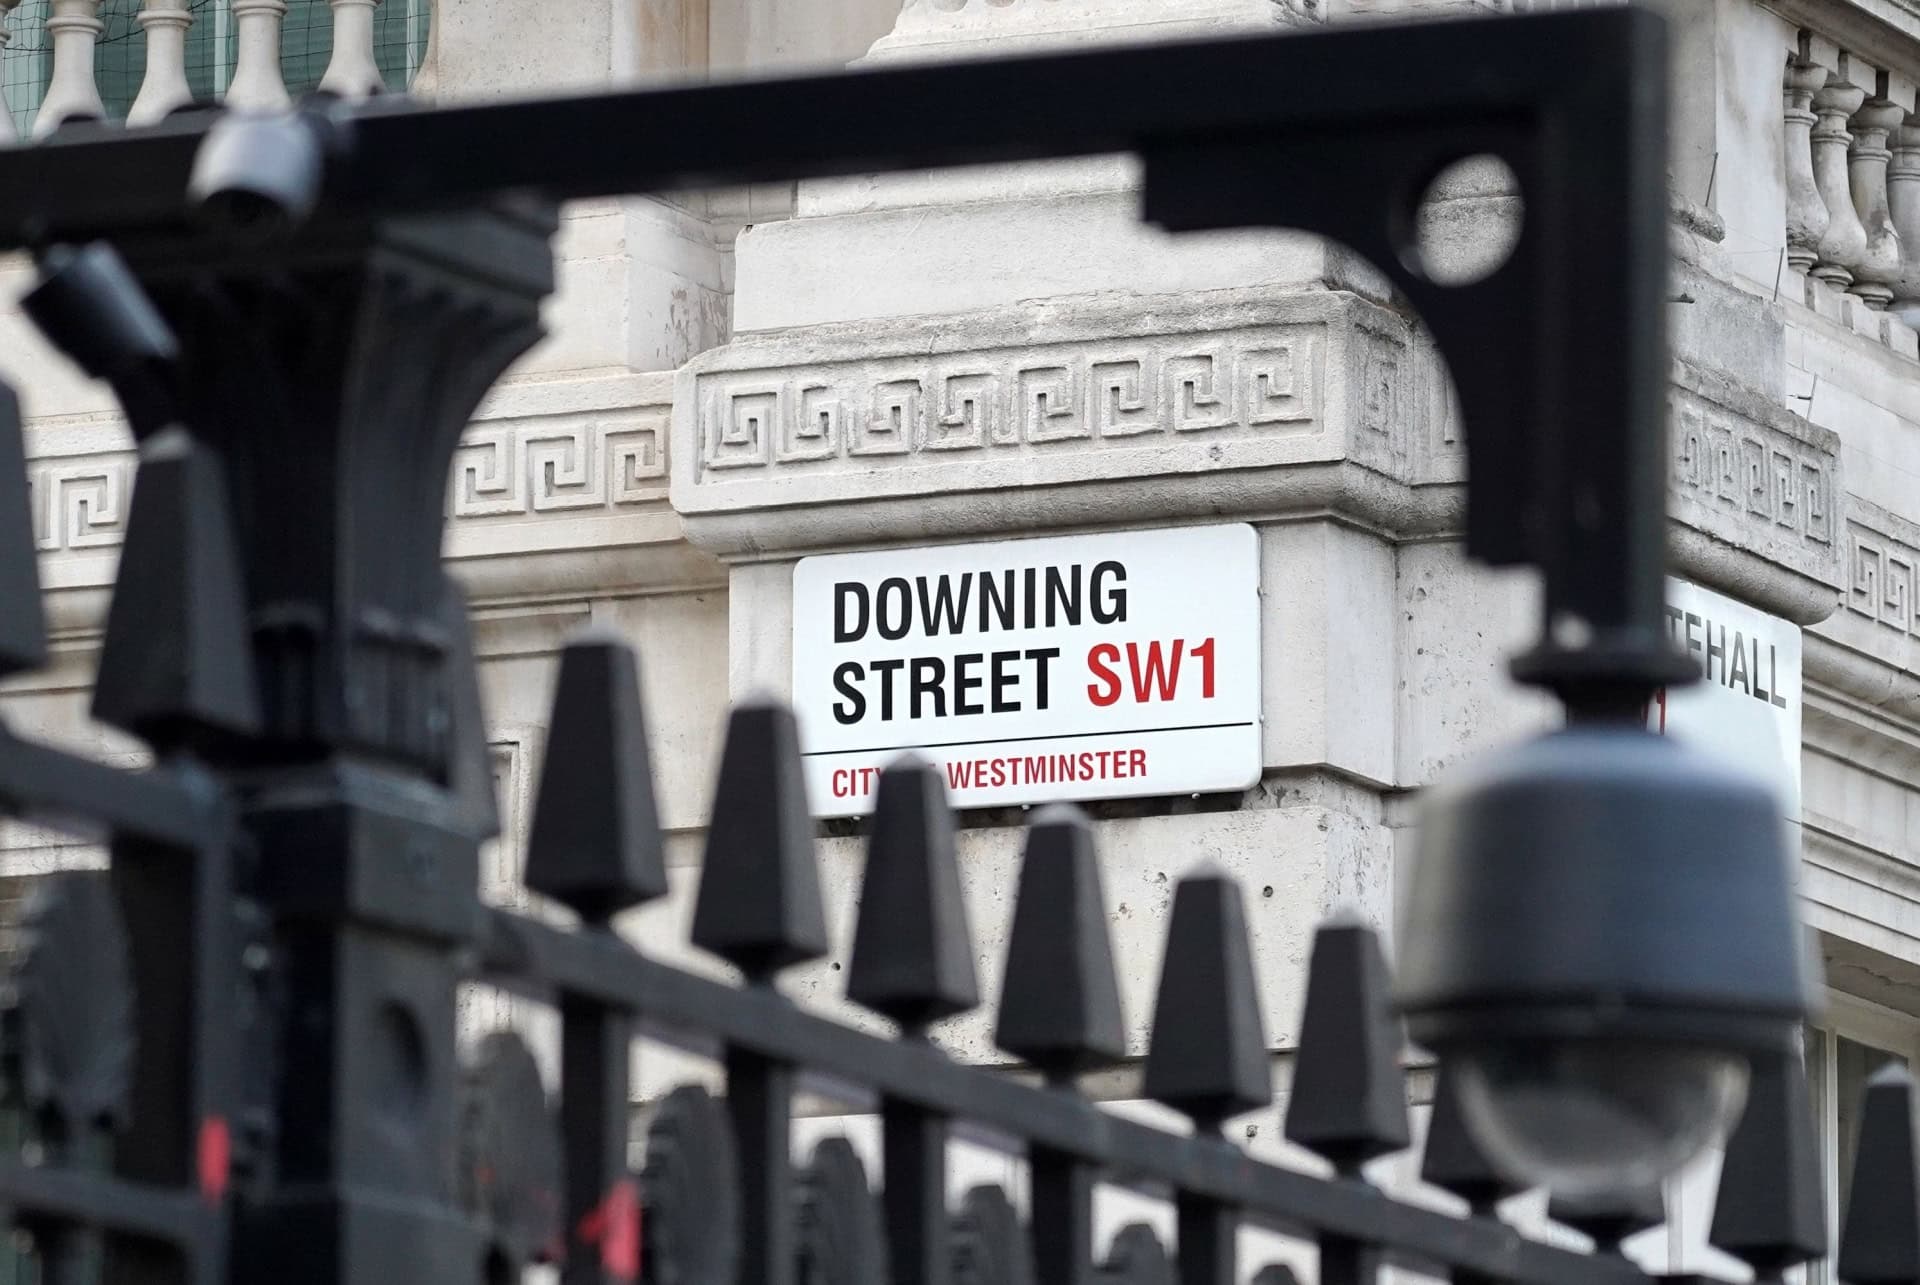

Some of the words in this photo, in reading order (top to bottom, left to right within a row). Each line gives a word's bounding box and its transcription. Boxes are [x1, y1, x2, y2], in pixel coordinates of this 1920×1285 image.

[834, 560, 1128, 643] DOWNING
[833, 648, 1060, 724] STREET
[1087, 638, 1215, 707] SW1
[1663, 605, 1786, 709] TEHALL
[947, 749, 1147, 790] WESTMINSTER
